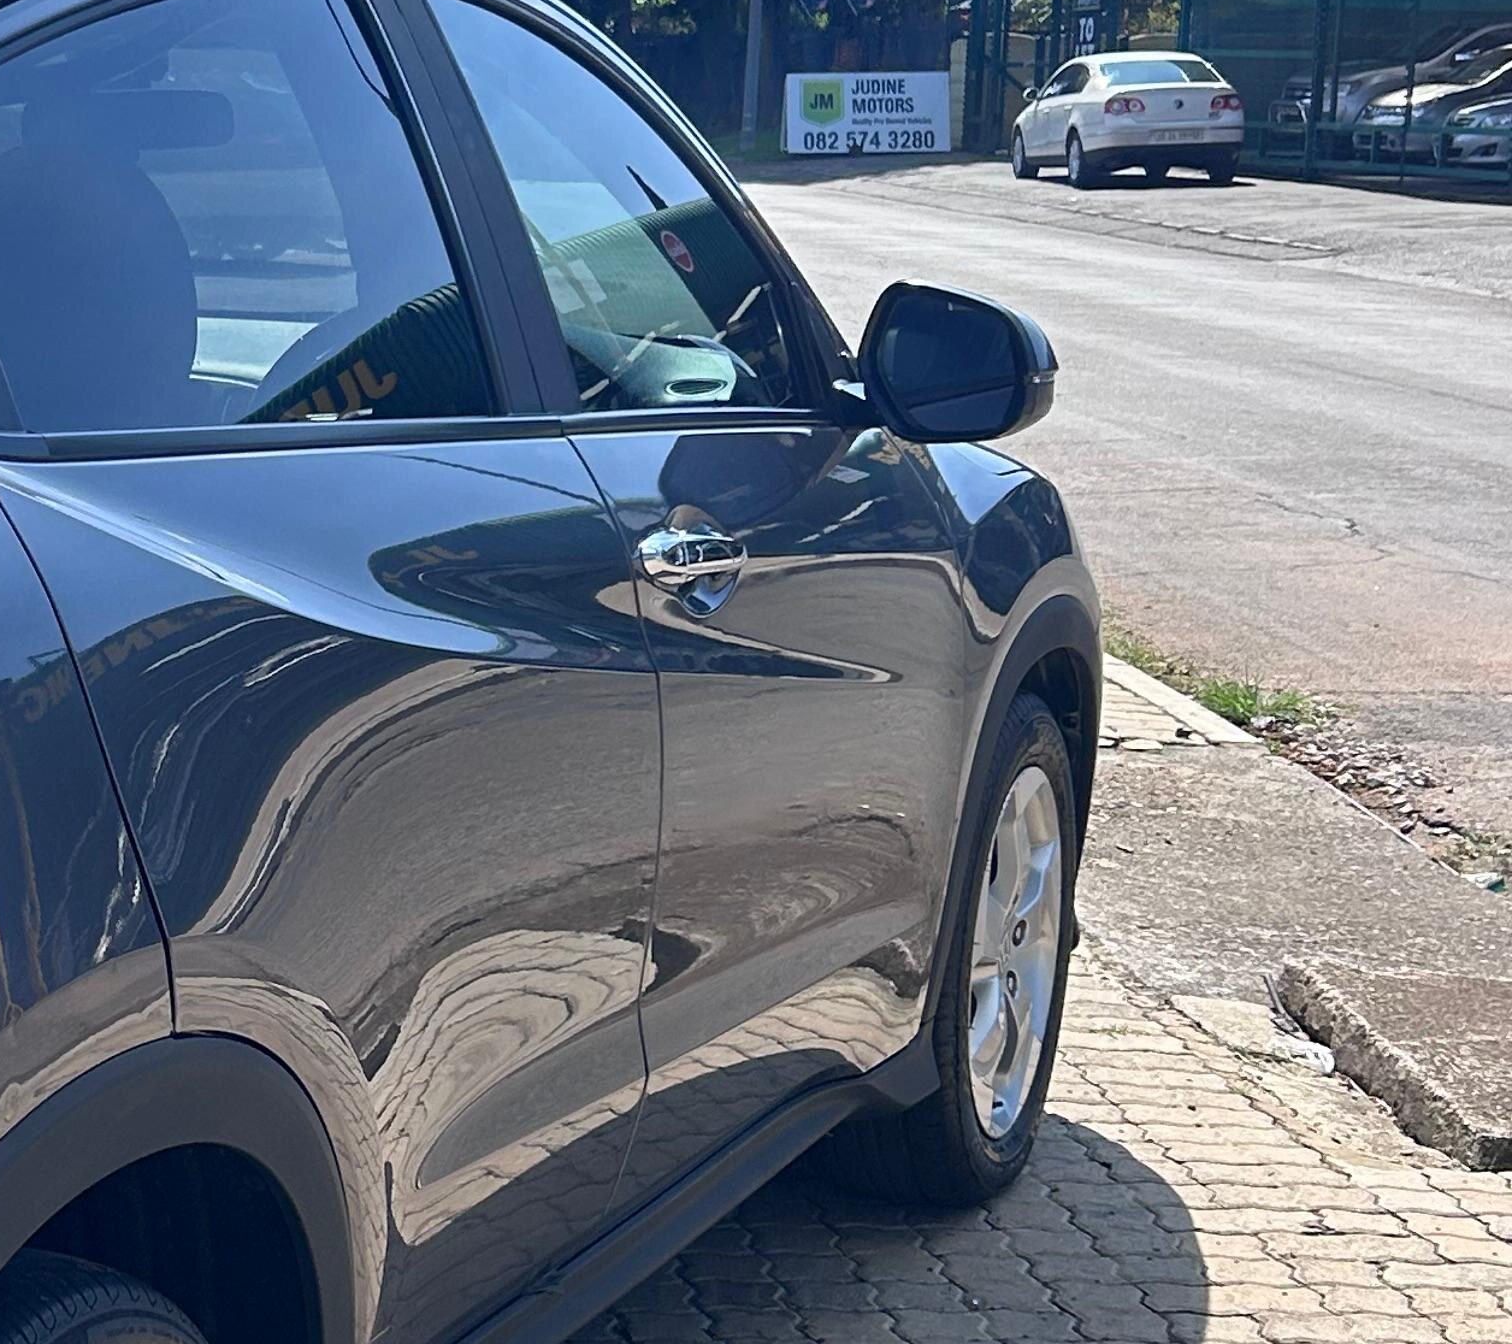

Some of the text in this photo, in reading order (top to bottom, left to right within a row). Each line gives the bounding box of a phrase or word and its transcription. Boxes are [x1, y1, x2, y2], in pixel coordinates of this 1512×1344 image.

[851, 78, 906, 95] JUDINE
[809, 93, 834, 110] JM
[851, 97, 915, 114] MOTORS
[803, 130, 935, 150] 082 574 3280
